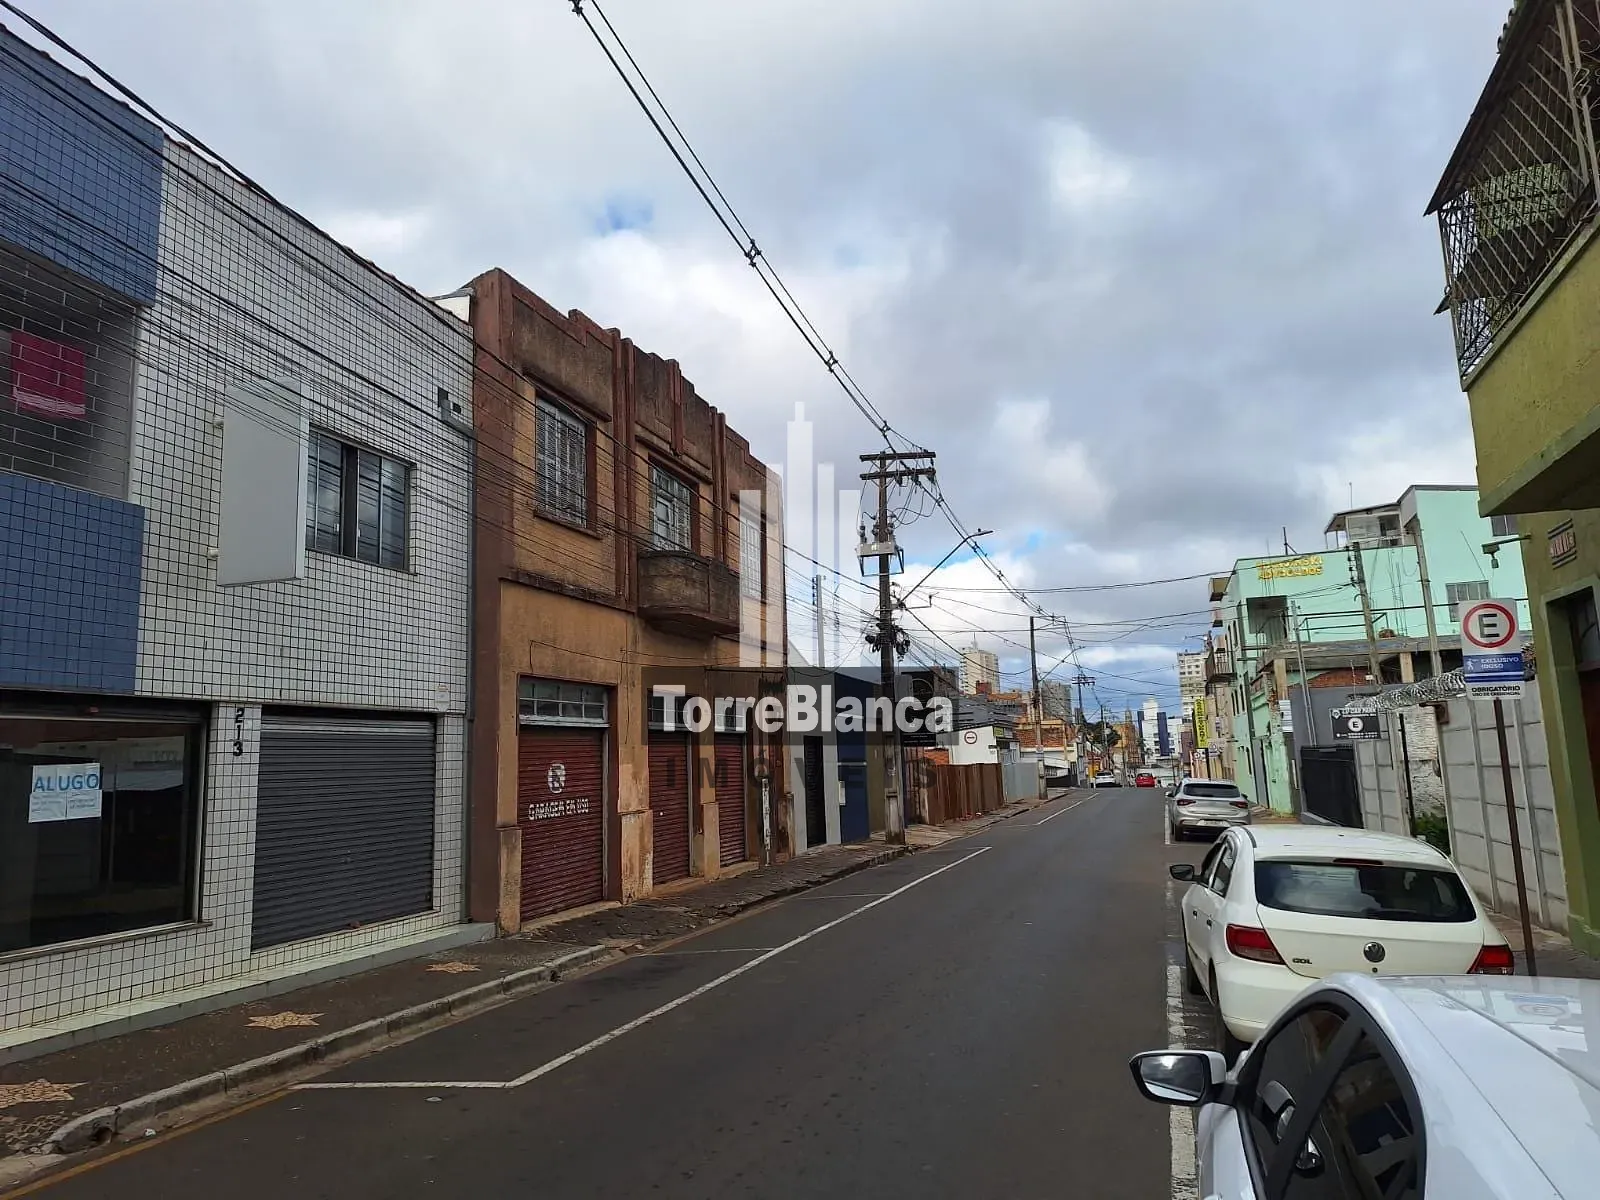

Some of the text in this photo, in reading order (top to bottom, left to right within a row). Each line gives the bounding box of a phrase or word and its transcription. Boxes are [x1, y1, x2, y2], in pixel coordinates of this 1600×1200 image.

[1478, 613, 1501, 639] E
[1471, 685, 1521, 693] OBRIGATÓRIO
[233, 708, 245, 757] 213
[33, 773, 99, 793] ALUGO
[528, 801, 565, 821] GARAGEM
[1292, 957, 1313, 965] GOL
